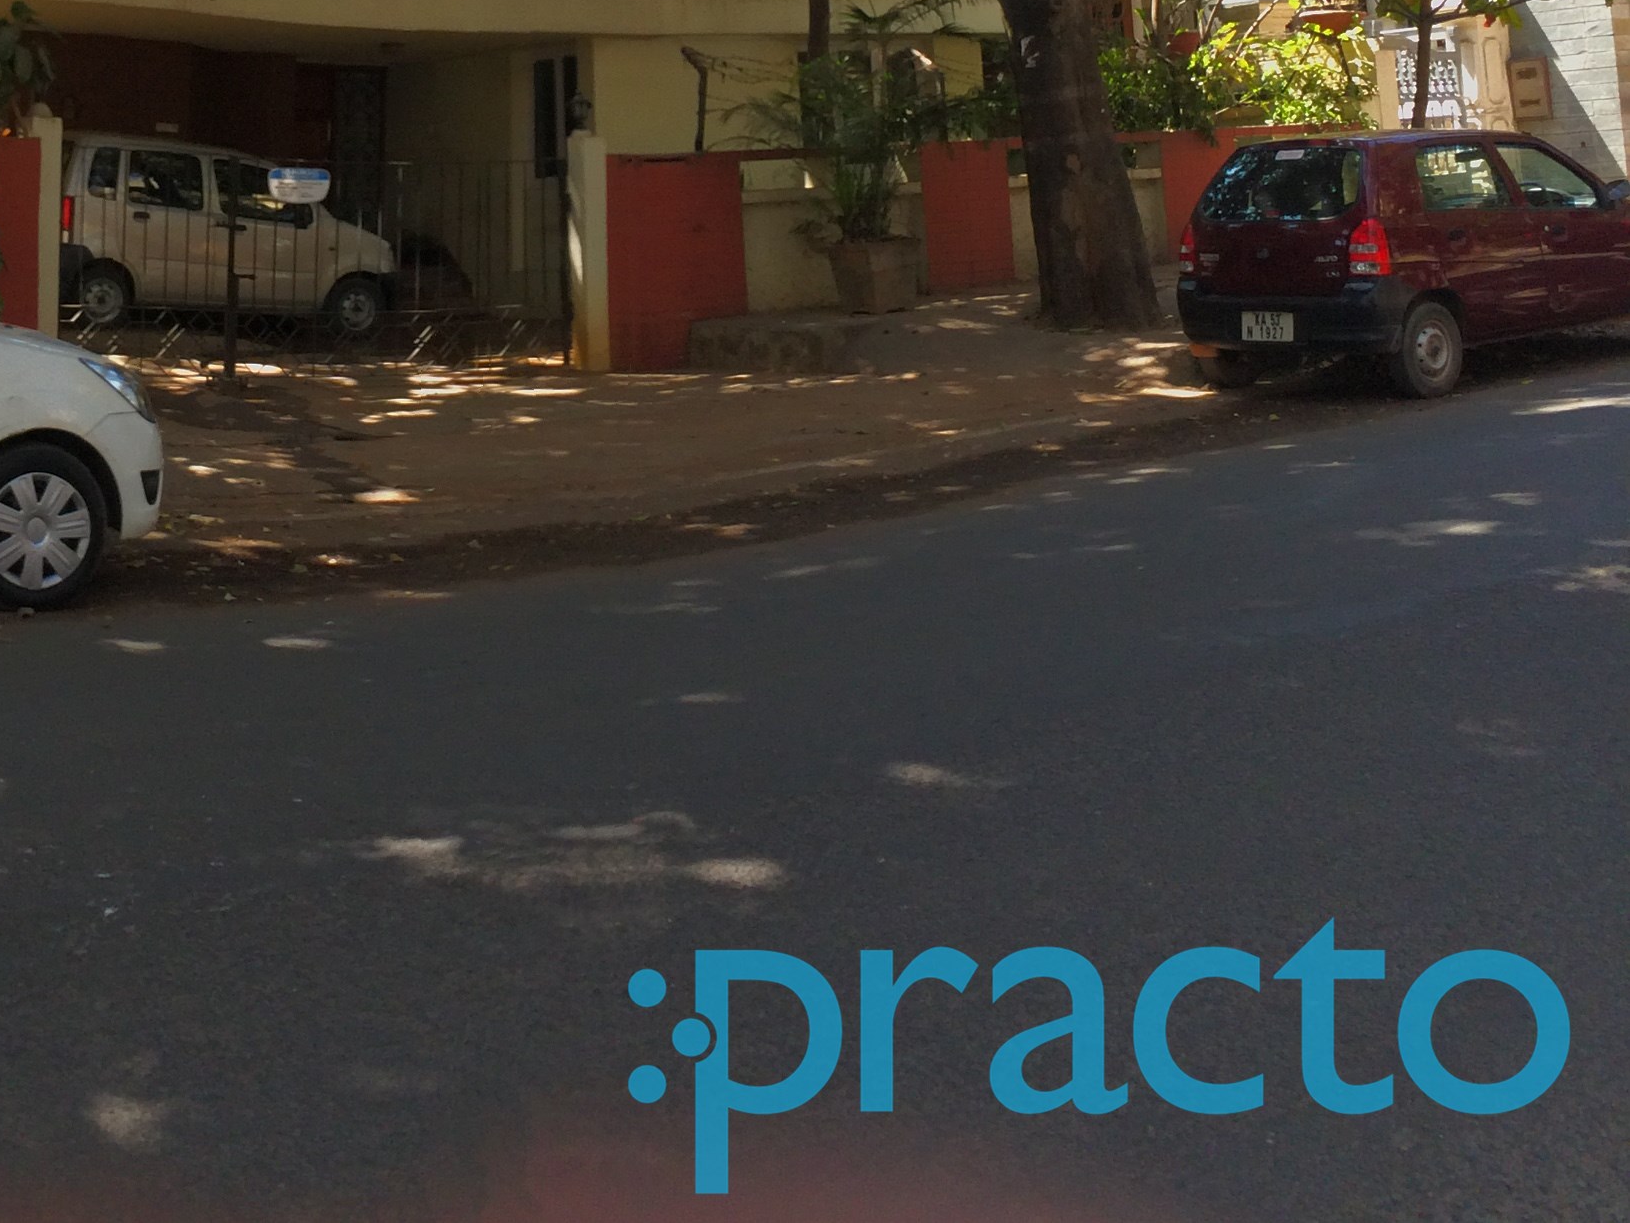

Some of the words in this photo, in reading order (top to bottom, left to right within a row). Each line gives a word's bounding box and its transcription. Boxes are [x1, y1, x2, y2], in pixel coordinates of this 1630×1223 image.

[1252, 313, 1266, 326] KA
[1271, 313, 1281, 326] 53
[1259, 326, 1285, 339] 1927
